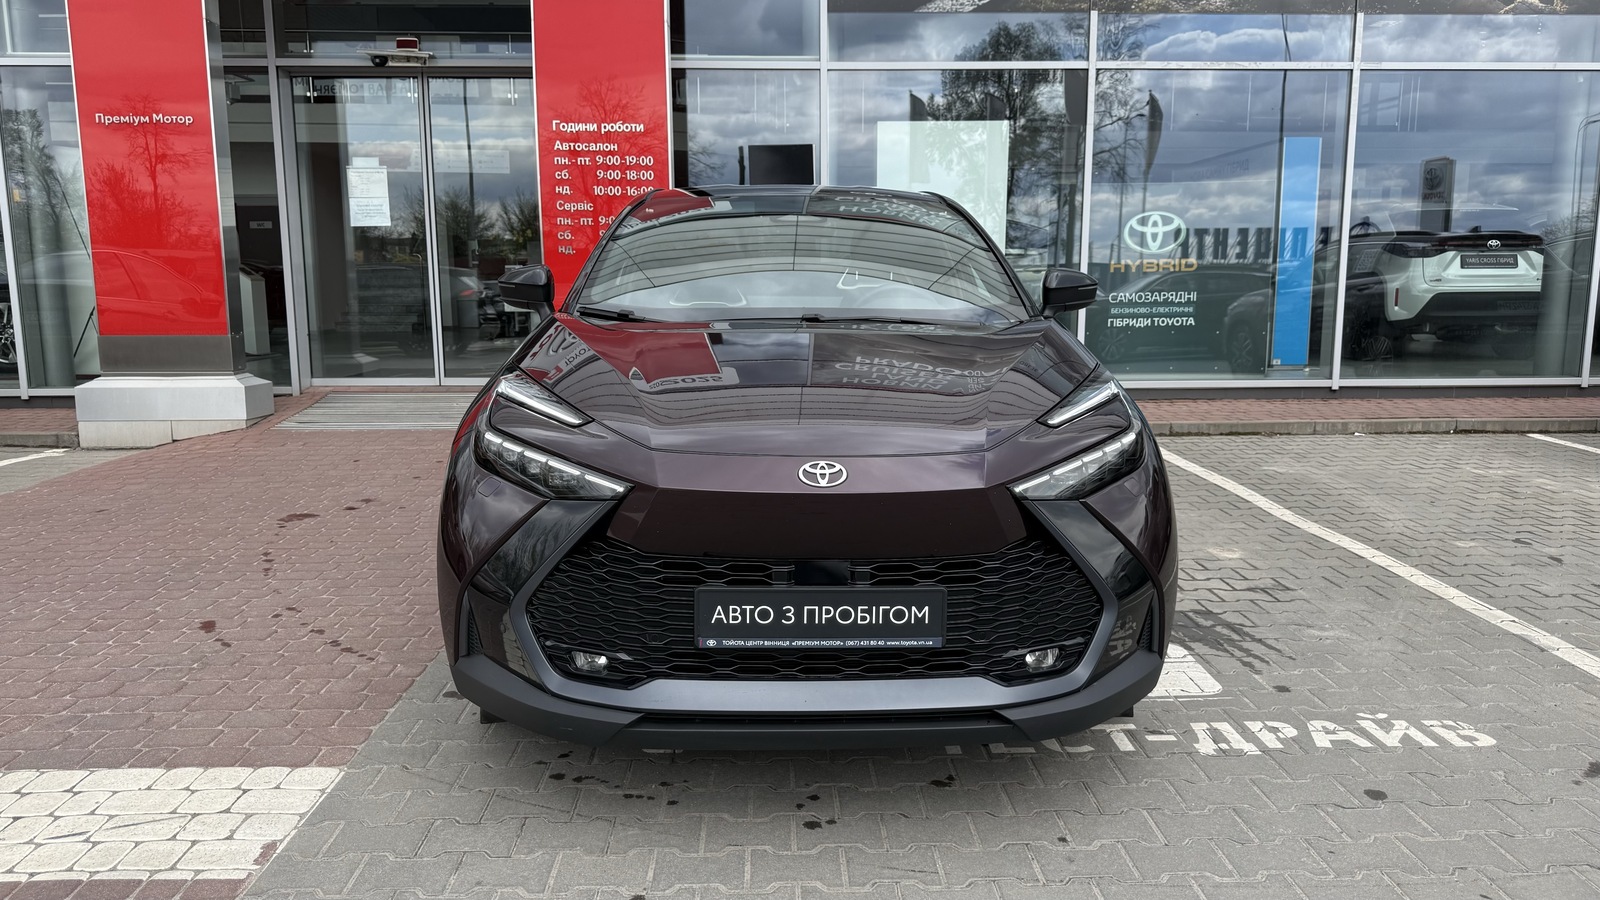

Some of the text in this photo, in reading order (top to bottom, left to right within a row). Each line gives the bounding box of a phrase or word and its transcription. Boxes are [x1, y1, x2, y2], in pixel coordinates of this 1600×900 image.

[95, 113, 194, 126] Преміум Мотор
[552, 120, 645, 134] Години роботи
[554, 140, 618, 151] Автосалон
[595, 154, 654, 166] 9:00-19:00
[555, 169, 654, 181] сб. 9:00-18:00
[555, 185, 573, 196] нд.
[556, 200, 594, 212] Сервіс
[557, 229, 575, 240] сб.
[558, 245, 576, 255] нд.
[1109, 258, 1198, 273] HYBRID
[1108, 291, 1197, 304] САМОЗАРЯДНІ
[1110, 306, 1194, 314] БЕНЗИНОВО-ЕЛЕКТРИЧНІ
[1107, 317, 1196, 328] ГІБРИДИ TOYOTA
[711, 605, 930, 624] АВТО З ПРОБІГОМ
